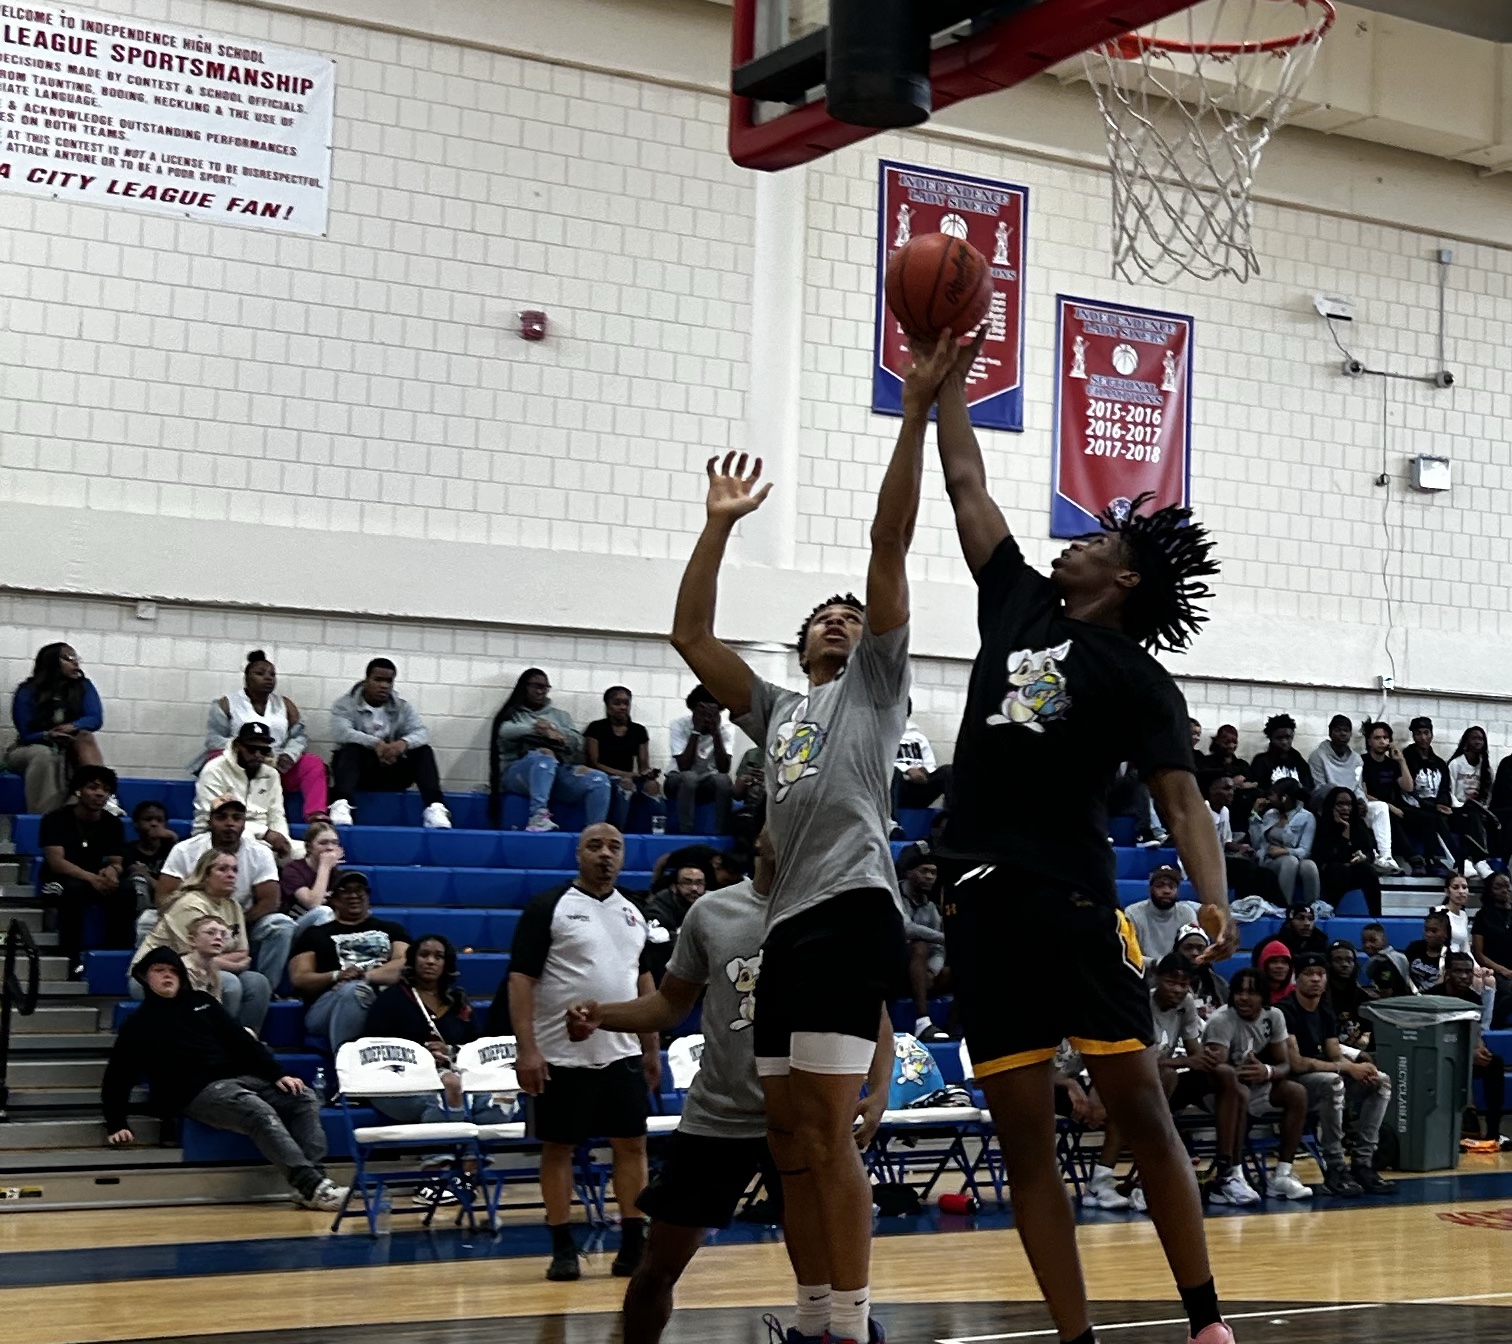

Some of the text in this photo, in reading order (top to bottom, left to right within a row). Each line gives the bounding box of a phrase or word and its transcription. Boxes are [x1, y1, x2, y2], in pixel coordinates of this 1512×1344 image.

[0, 4, 265, 64] ELCOME TO INDEPENDENCE HIGH SCHOOL
[4, 24, 314, 96] LEAGUE SPORTSMANSHIP
[0, 69, 26, 82] ROM
[154, 95, 210, 113] HECKLING
[228, 107, 249, 121] THE
[254, 112, 276, 125] USE
[67, 64, 102, 79] MADE
[107, 70, 121, 82] BY
[127, 74, 180, 92] CONTEST
[185, 84, 194, 95] &
[200, 86, 244, 104] SCHOOL
[21, 115, 38, 126] ON
[44, 118, 77, 133] BOTH
[24, 102, 114, 127] ACKNOWLEDGE
[119, 118, 201, 141] OUTSTANDING
[206, 132, 298, 157] PERFORMANCES
[7, 129, 21, 140] AT
[26, 131, 50, 145] THIS
[55, 137, 105, 153] CONTEST
[108, 145, 119, 156] IS
[124, 147, 146, 159] NOT
[161, 153, 205, 169] LICENSE
[208, 160, 222, 172] TO
[226, 163, 238, 175] BE
[7, 142, 49, 157] ATTACK
[101, 156, 116, 167] OR
[120, 159, 133, 170] TO
[27, 168, 96, 190] CITY
[106, 179, 217, 209] LEAGUE
[226, 197, 294, 221] FAN!
[898, 174, 1011, 206] INDEPENDENCE
[908, 189, 1000, 216] LADY SIXERS
[1074, 307, 1177, 335] INDEPENDENCE
[1083, 322, 1168, 345] LADY SIXERS
[1086, 384, 1164, 406] CHAMPIONS
[1090, 374, 1159, 395] SECTIONAL
[1086, 399, 1162, 425] 2015-2016
[1085, 419, 1162, 444] 2016-2017
[1084, 438, 1161, 464] 2017-2018
